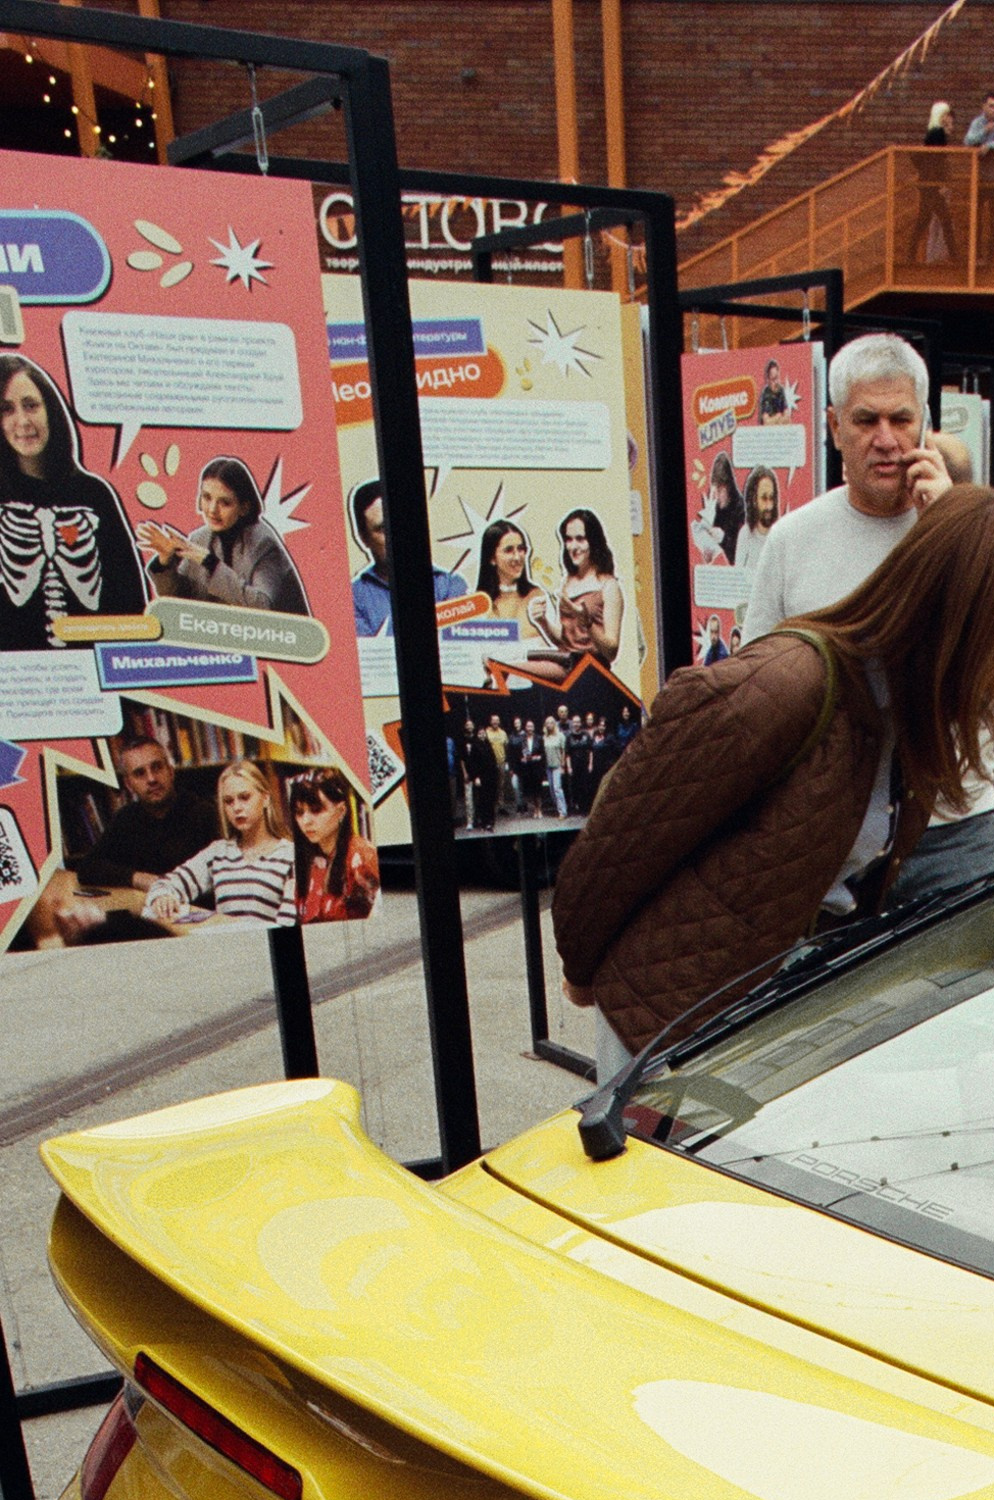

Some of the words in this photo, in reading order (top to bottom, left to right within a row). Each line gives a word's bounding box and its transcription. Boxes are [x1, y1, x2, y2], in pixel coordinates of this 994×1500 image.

[179, 612, 297, 645] Екатерина
[451, 626, 509, 638] Назаров
[112, 654, 243, 670] Михальченко
[791, 1154, 954, 1220] PORSCHE
